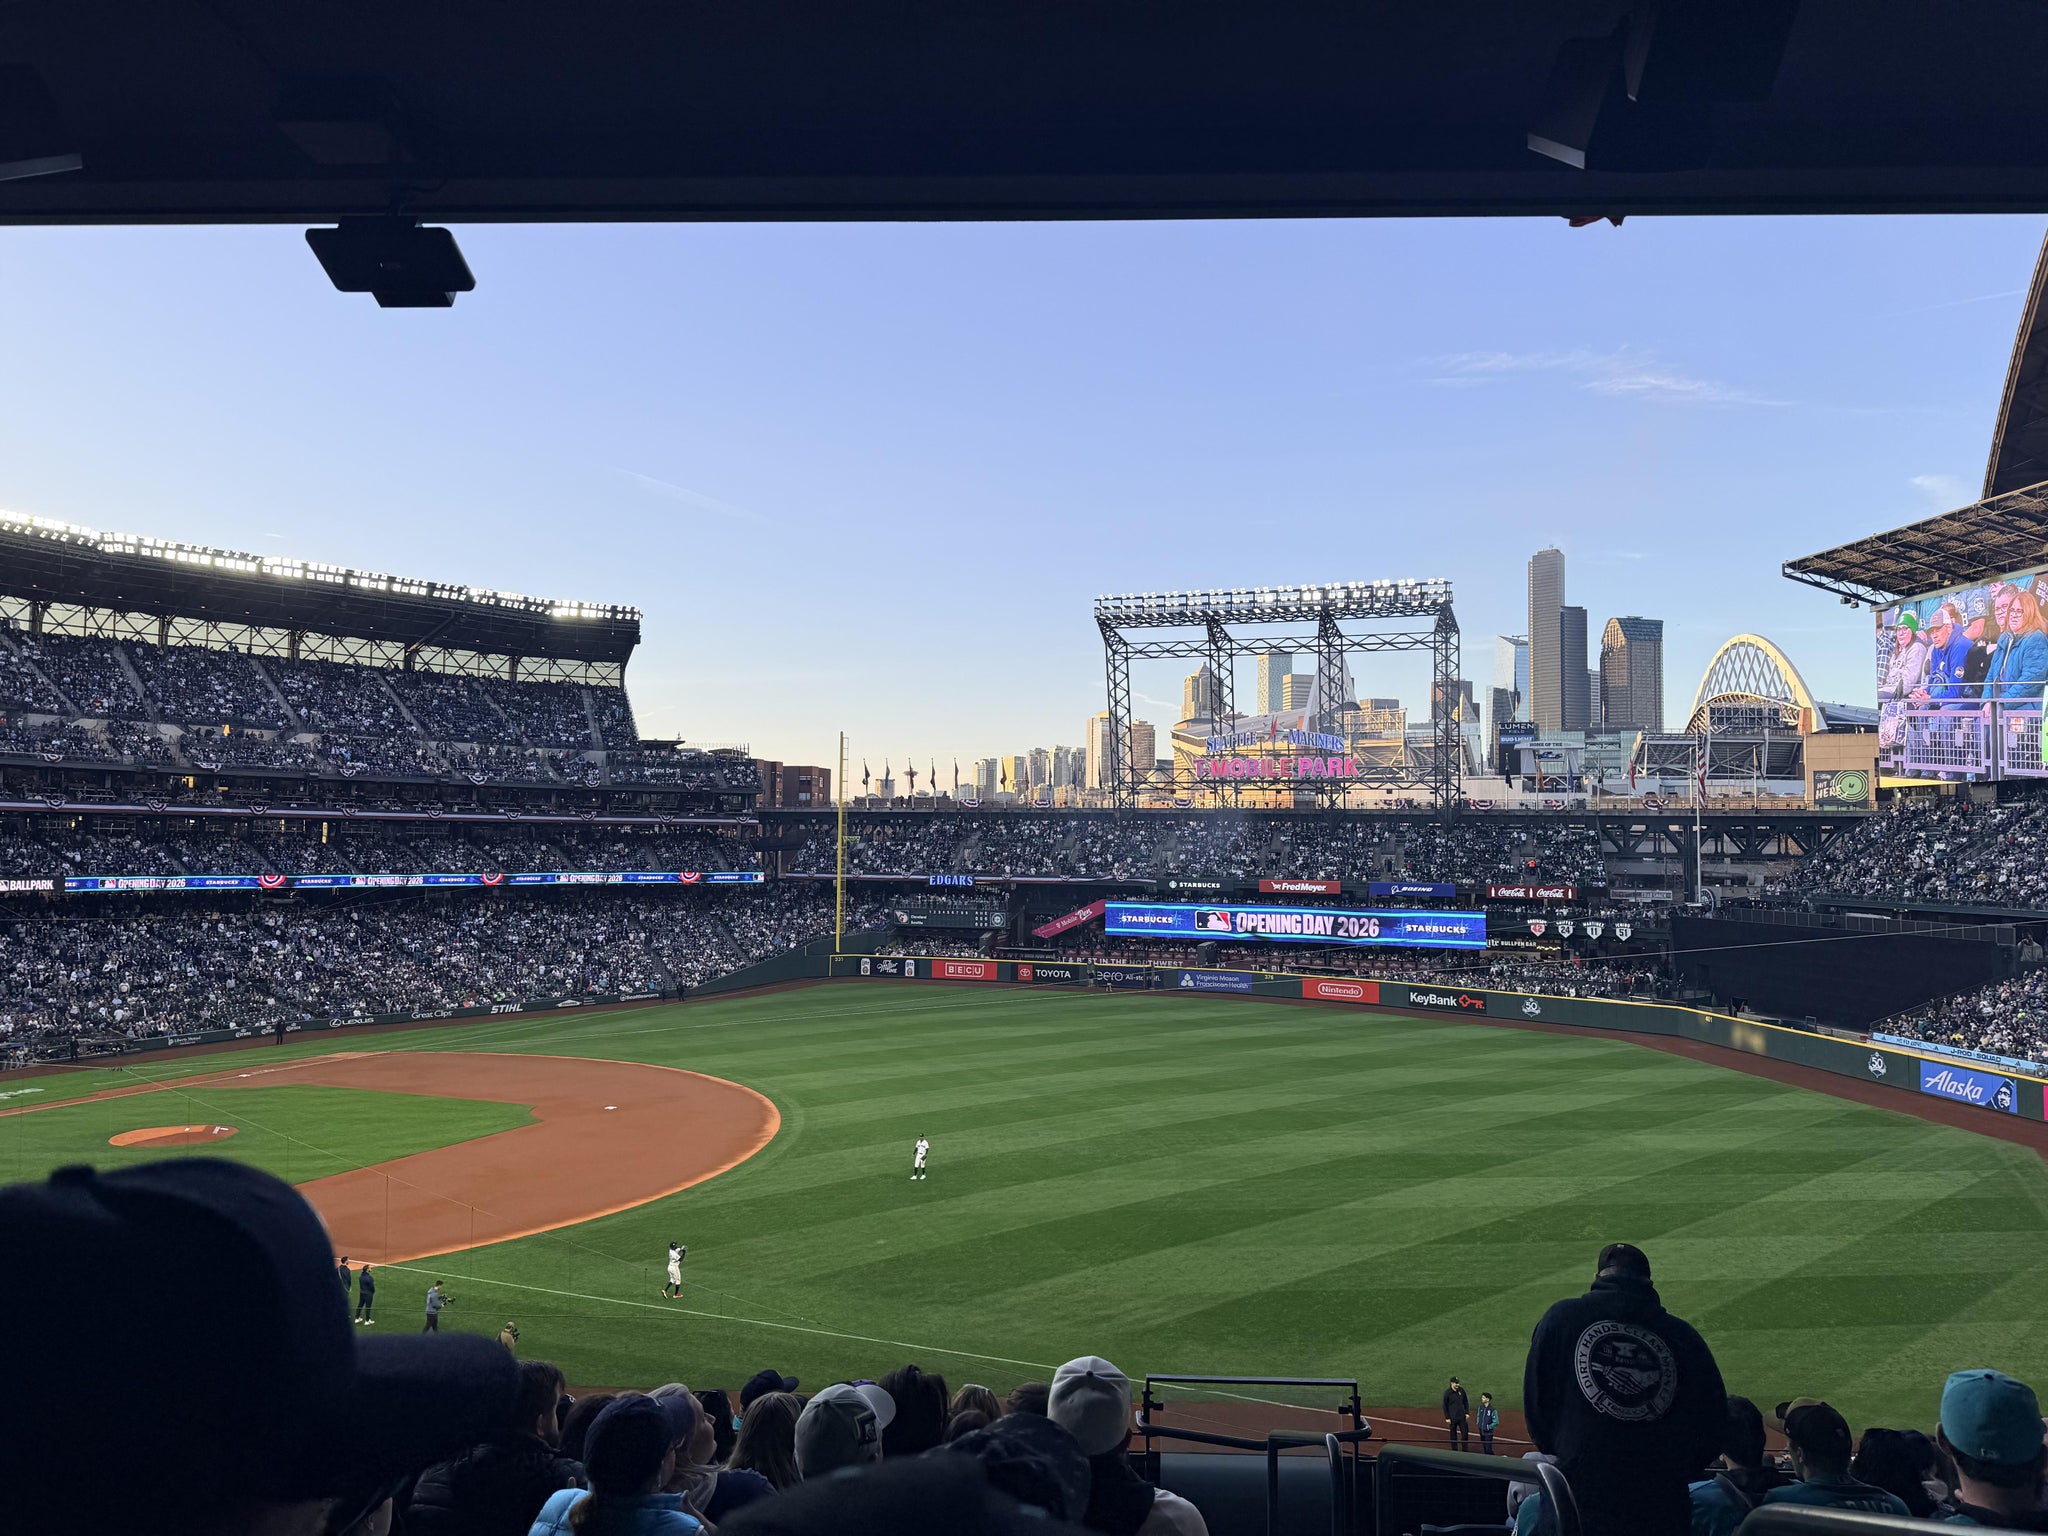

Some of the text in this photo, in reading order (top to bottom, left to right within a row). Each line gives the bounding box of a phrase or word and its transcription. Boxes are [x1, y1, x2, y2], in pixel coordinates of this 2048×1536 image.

[1206, 729, 1345, 752] SEATTLE MARINERS
[1194, 757, 1360, 778] T-MOBILE PARK
[1817, 781, 1827, 789] HIT
[1815, 785, 1841, 800] HERE
[408, 876, 424, 885] 2026
[608, 874, 622, 882] 2026
[929, 875, 974, 886] EDGARS
[9, 880, 54, 891] BALLPARK
[118, 878, 186, 889] OPENING DAY 2026
[1498, 887, 1526, 897] Coca-Cola
[1536, 888, 1565, 898] Coca-Cola
[1074, 908, 1093, 921] Pen
[1121, 915, 1174, 924] STARBUCKS
[1236, 912, 1380, 938] OPENING DAY 2026
[1406, 924, 1467, 934] STARBUCKS
[1532, 925, 1543, 933] 42
[1590, 927, 1598, 936] 11
[1618, 928, 1628, 937] 51
[948, 965, 981, 975] BECU
[1036, 969, 1071, 979] TOYOTA
[1196, 974, 1219, 982] Virginia
[1321, 985, 1360, 995] Nintendo
[1410, 992, 1457, 1007] KeyBank
[490, 1003, 524, 1014] STIHL
[1525, 1001, 1538, 1010] 50
[411, 1009, 452, 1019] Great Clips
[342, 1017, 374, 1025] LEXUS
[1950, 1048, 2002, 1063] J-ROD SQUAD
[1871, 1056, 1883, 1069] 50
[1925, 1070, 1984, 1101] Alaska
[1582, 1324, 1619, 1348] HANDS
[1579, 1352, 1593, 1389] DIRTY
